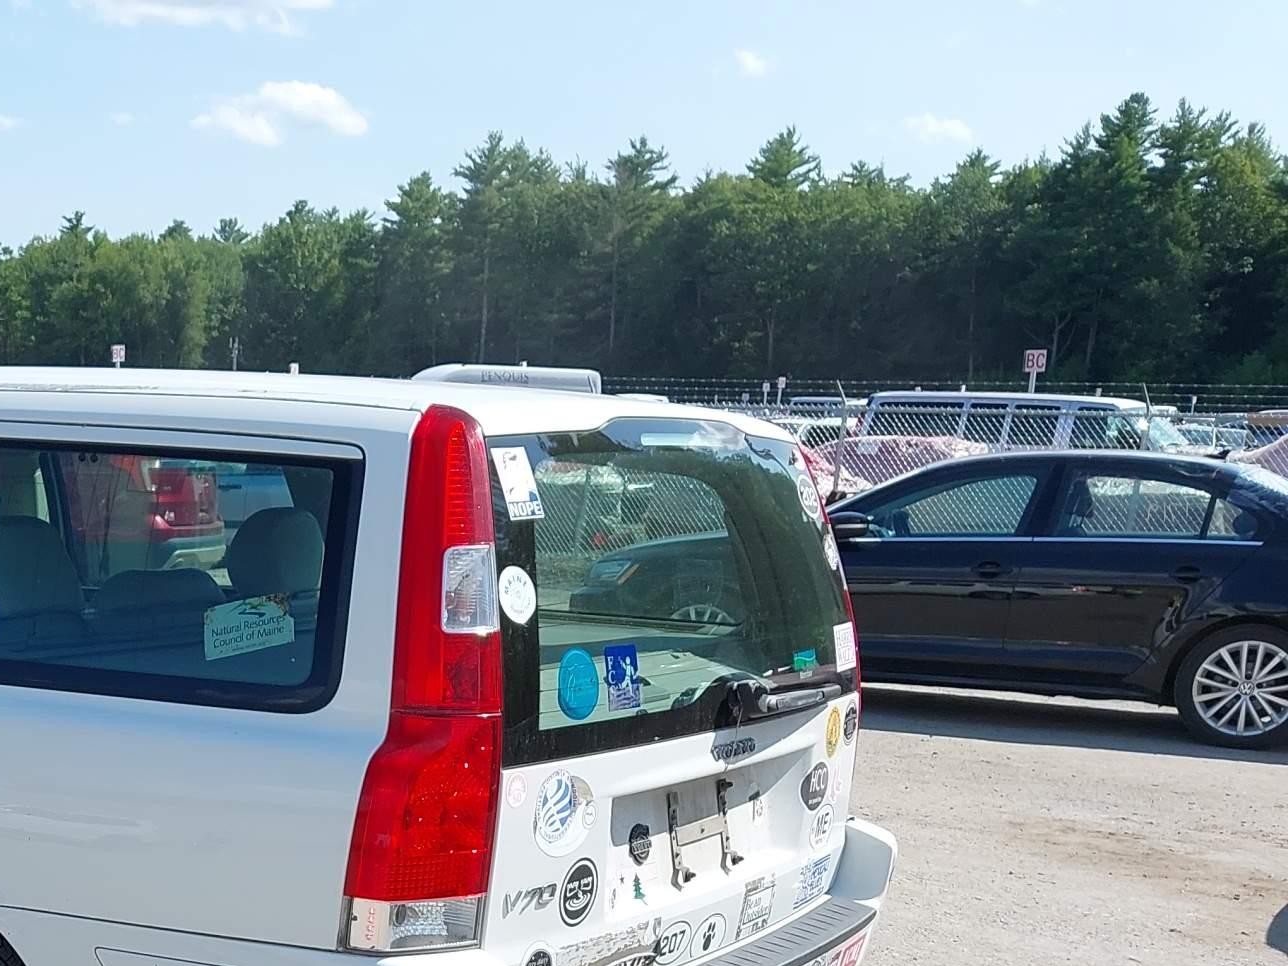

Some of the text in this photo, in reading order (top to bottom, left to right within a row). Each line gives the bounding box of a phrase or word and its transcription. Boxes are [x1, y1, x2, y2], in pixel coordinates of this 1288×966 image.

[1026, 352, 1045, 369] BC
[481, 370, 529, 384] PENQUIS
[508, 501, 542, 517] NOPE
[212, 614, 286, 638] Natural Resources
[213, 632, 244, 648] Council
[245, 630, 255, 641] of
[257, 625, 285, 639] Maine
[711, 737, 756, 762] VOLVO
[502, 883, 558, 920] V70
[661, 929, 687, 958] 207
